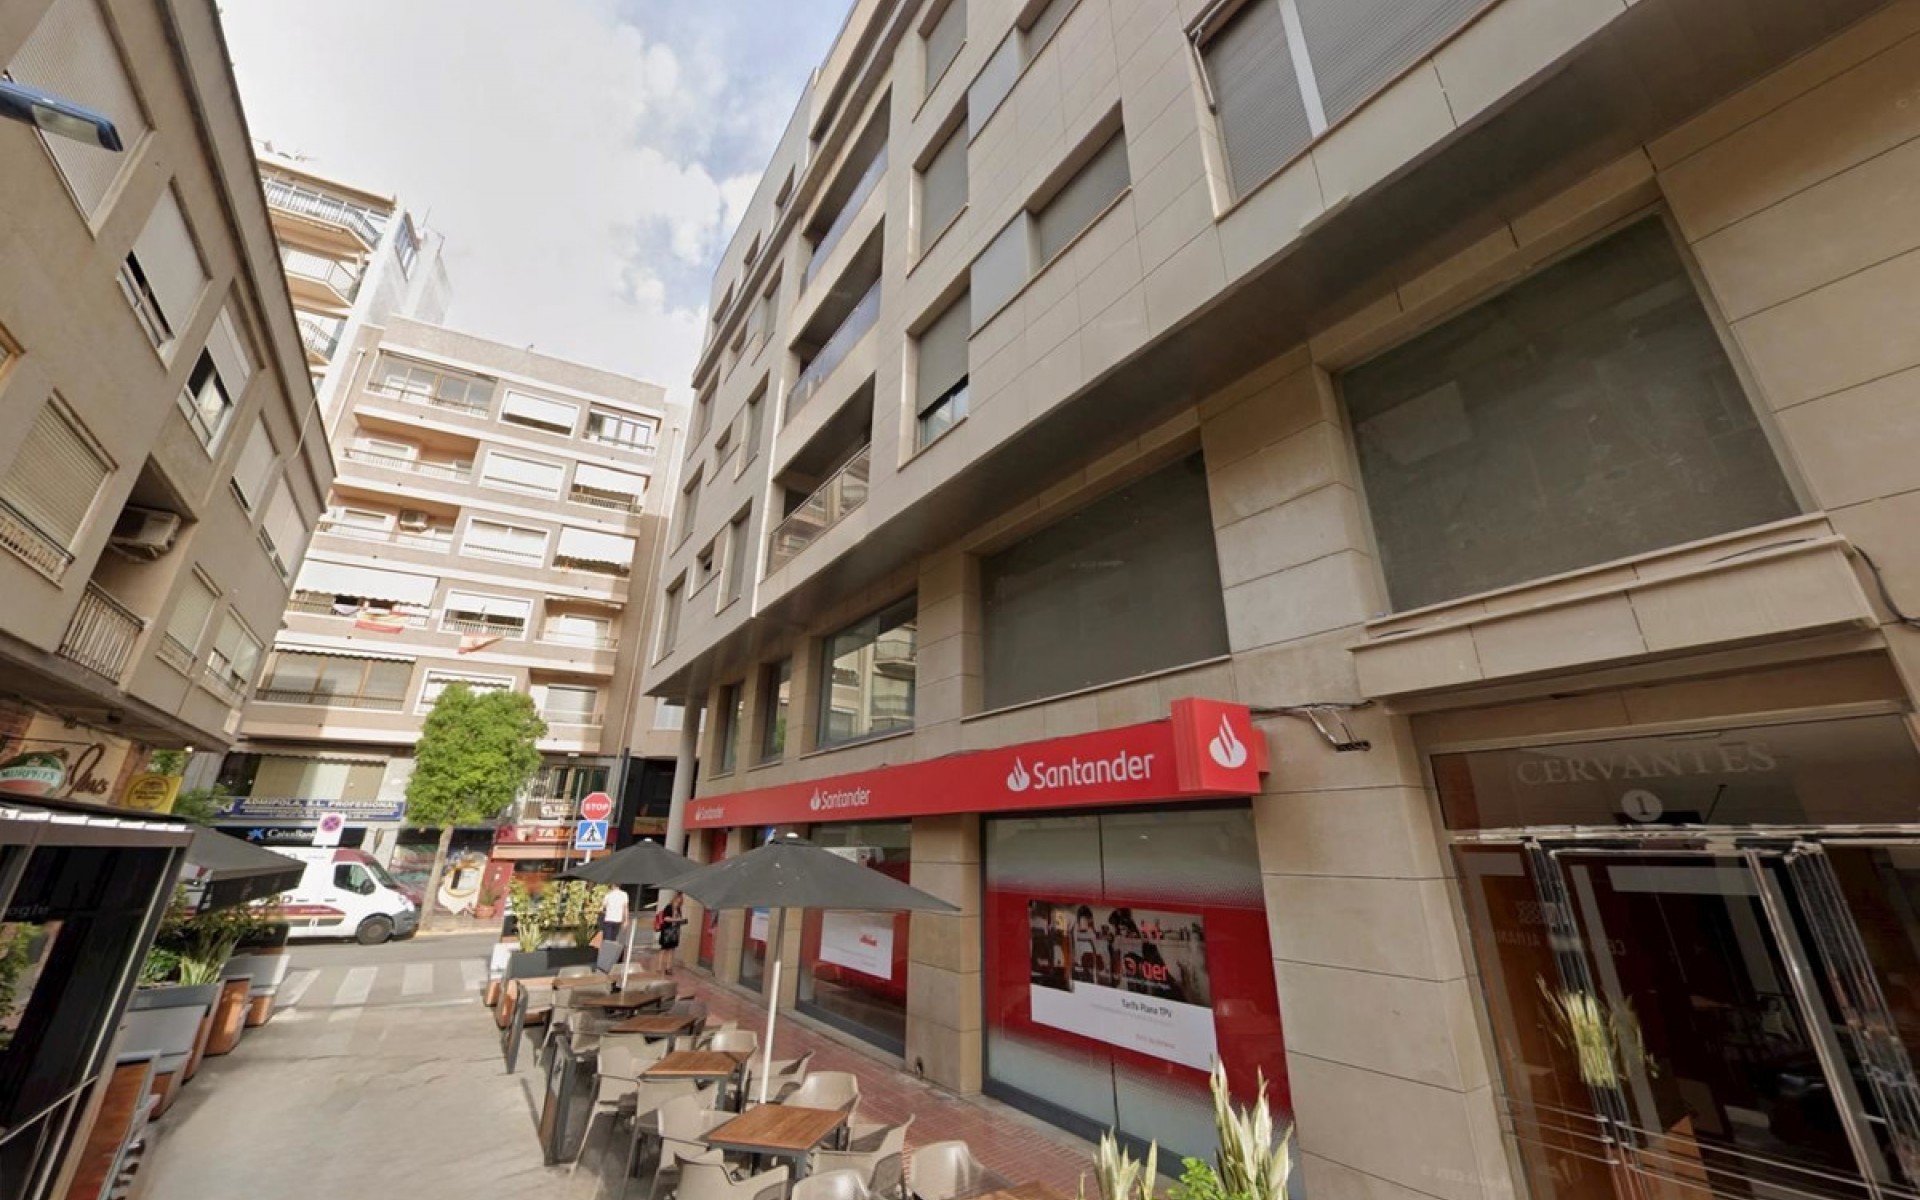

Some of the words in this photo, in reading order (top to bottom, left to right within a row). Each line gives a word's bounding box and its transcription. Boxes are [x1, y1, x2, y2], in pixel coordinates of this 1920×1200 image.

[1033, 750, 1154, 790] Santander
[1516, 742, 1778, 785] CERVANTES
[584, 803, 609, 812] STOP
[821, 787, 871, 810] Santander
[1635, 796, 1649, 816] 1
